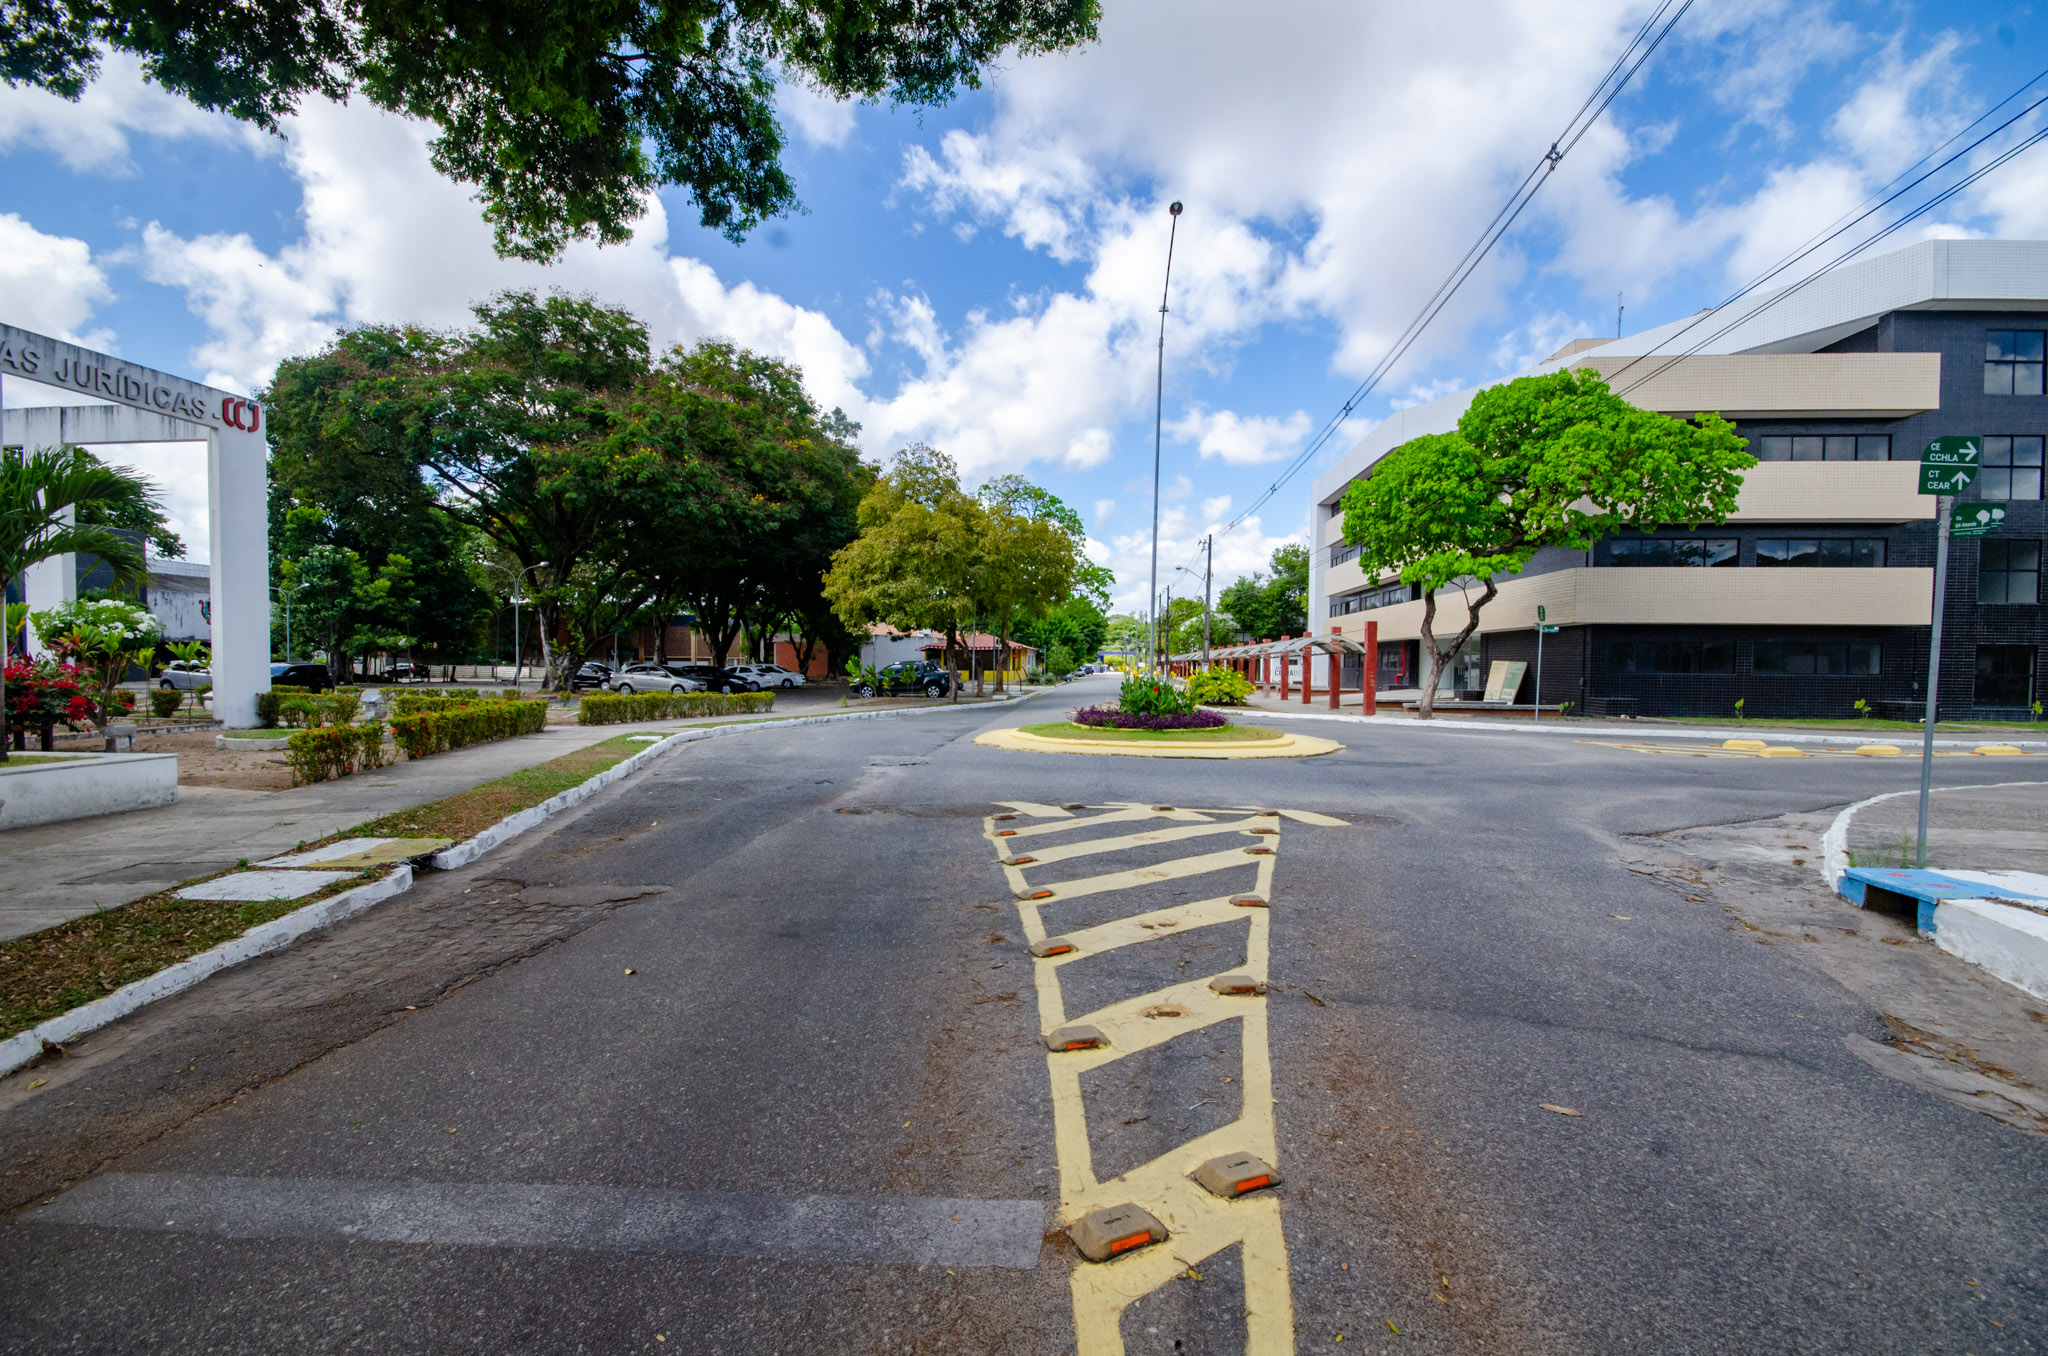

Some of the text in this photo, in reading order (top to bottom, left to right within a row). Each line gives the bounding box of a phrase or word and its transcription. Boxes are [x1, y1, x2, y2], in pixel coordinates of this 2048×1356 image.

[55, 358, 207, 419] JURÍDICAS
[221, 397, 260, 433] CCJ
[1931, 443, 1941, 451] CE
[1930, 453, 1959, 462] CCHLA
[1928, 470, 1940, 478] CT
[1927, 481, 1951, 490] CEAR
